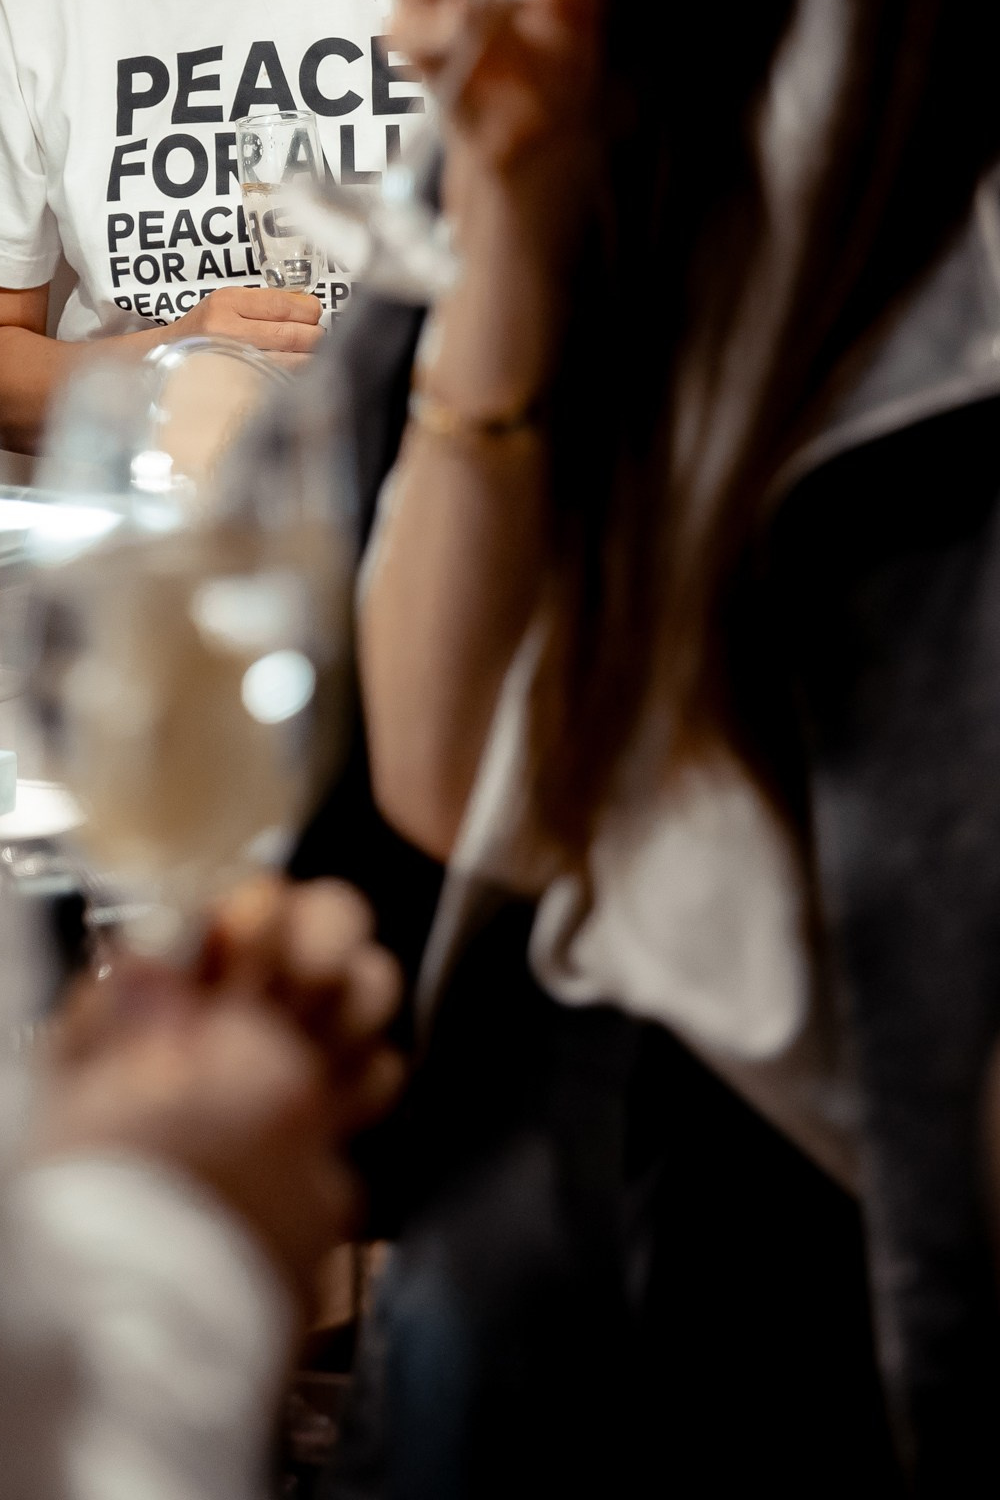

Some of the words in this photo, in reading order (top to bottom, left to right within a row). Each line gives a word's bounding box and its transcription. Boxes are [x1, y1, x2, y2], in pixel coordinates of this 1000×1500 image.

[116, 35, 426, 137] PEACE
[106, 132, 263, 202] FOR
[110, 252, 187, 288] FOR
[196, 247, 262, 281] ALL
[113, 288, 213, 317] PEAC
